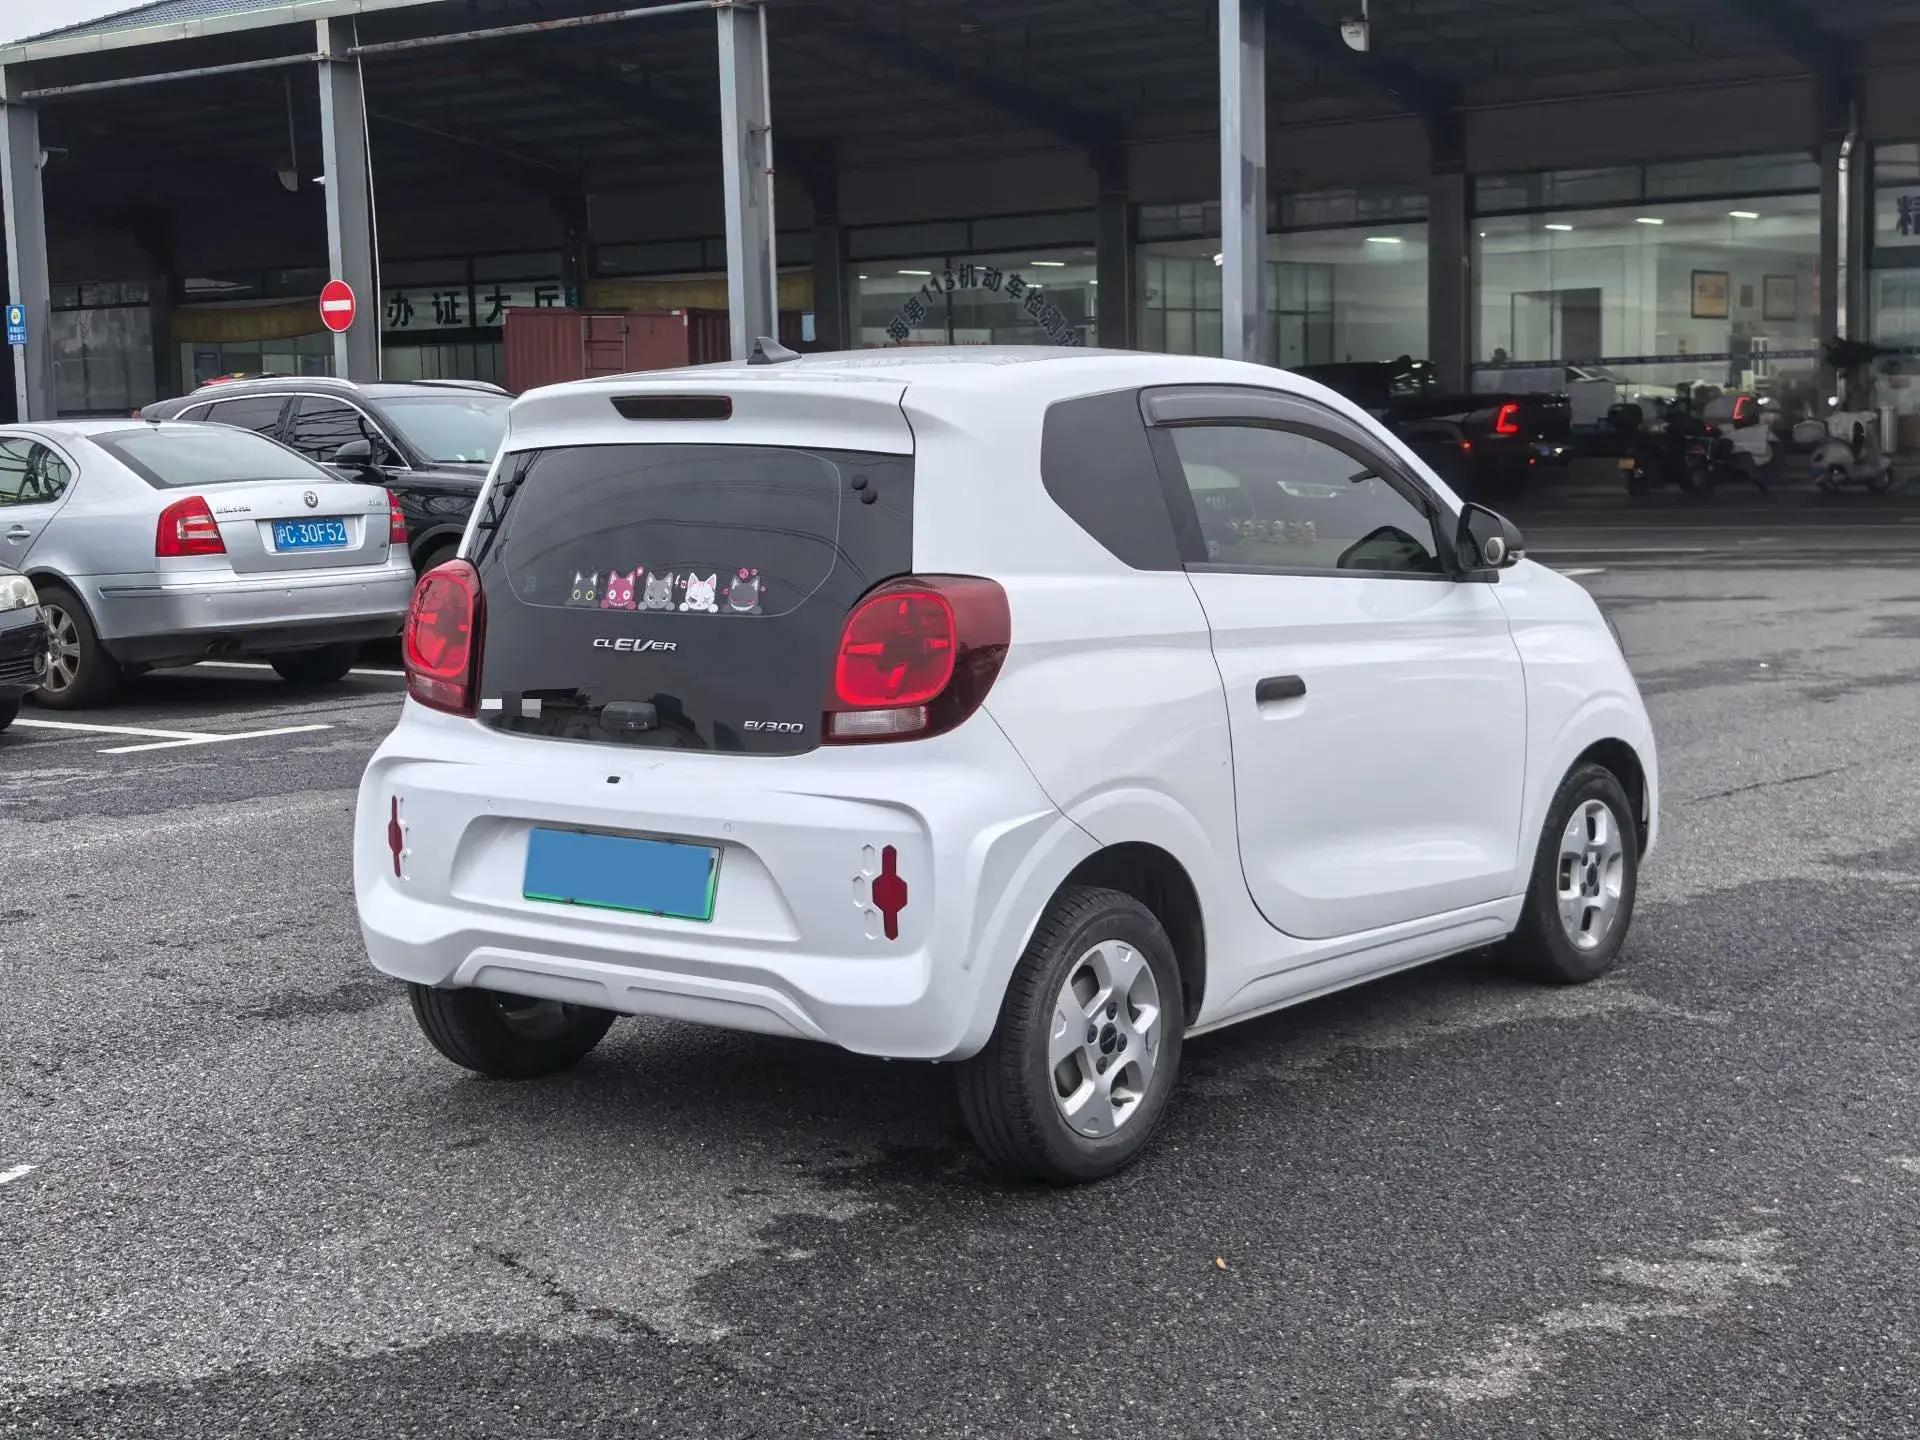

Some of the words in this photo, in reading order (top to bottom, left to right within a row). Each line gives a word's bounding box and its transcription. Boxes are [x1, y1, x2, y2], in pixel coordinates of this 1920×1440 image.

[884, 263, 1083, 346] 海第113机动车检测站
[593, 638, 677, 652] CLEVER
[743, 720, 804, 733] EV300
